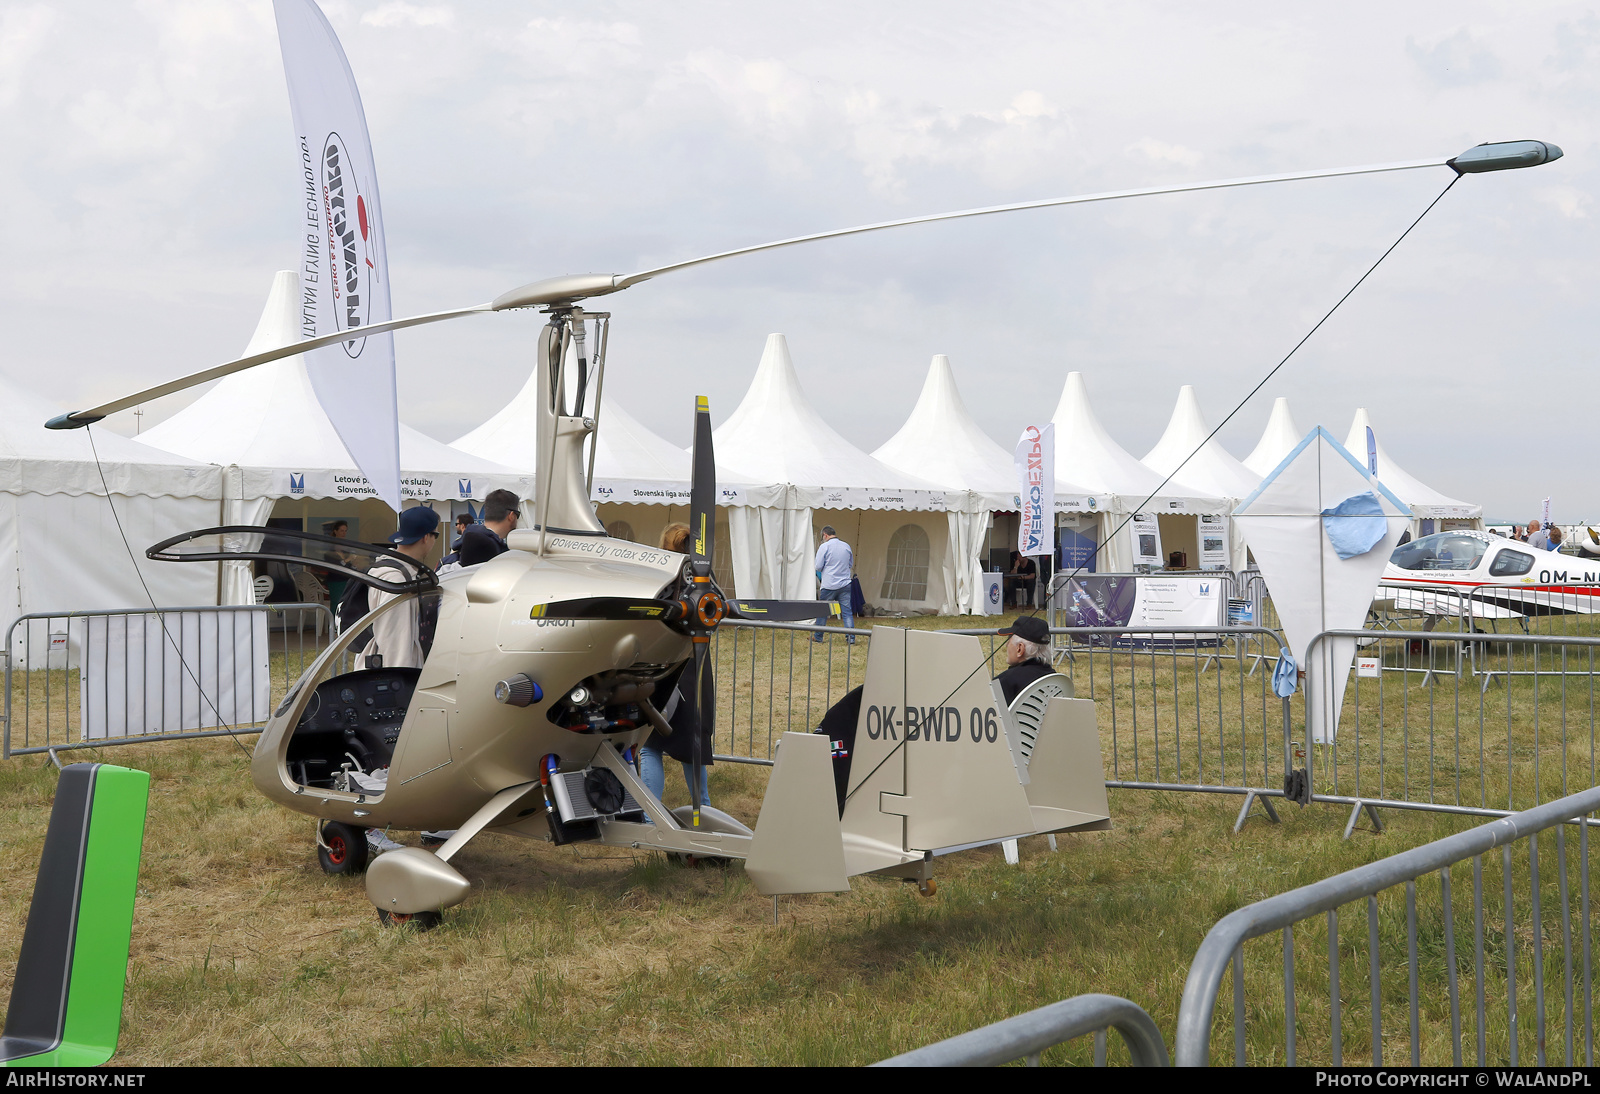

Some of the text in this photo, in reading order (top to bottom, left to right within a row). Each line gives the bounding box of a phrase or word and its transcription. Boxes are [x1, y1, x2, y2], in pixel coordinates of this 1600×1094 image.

[334, 475, 361, 483] Letové
[410, 478, 433, 487] služby
[633, 489, 665, 497] Slovenská
[666, 489, 677, 498] liga
[551, 536, 671, 565] powered by rotax 915 iS
[1539, 570, 1600, 588] OM-N
[866, 705, 998, 743] OK-BWD 06
